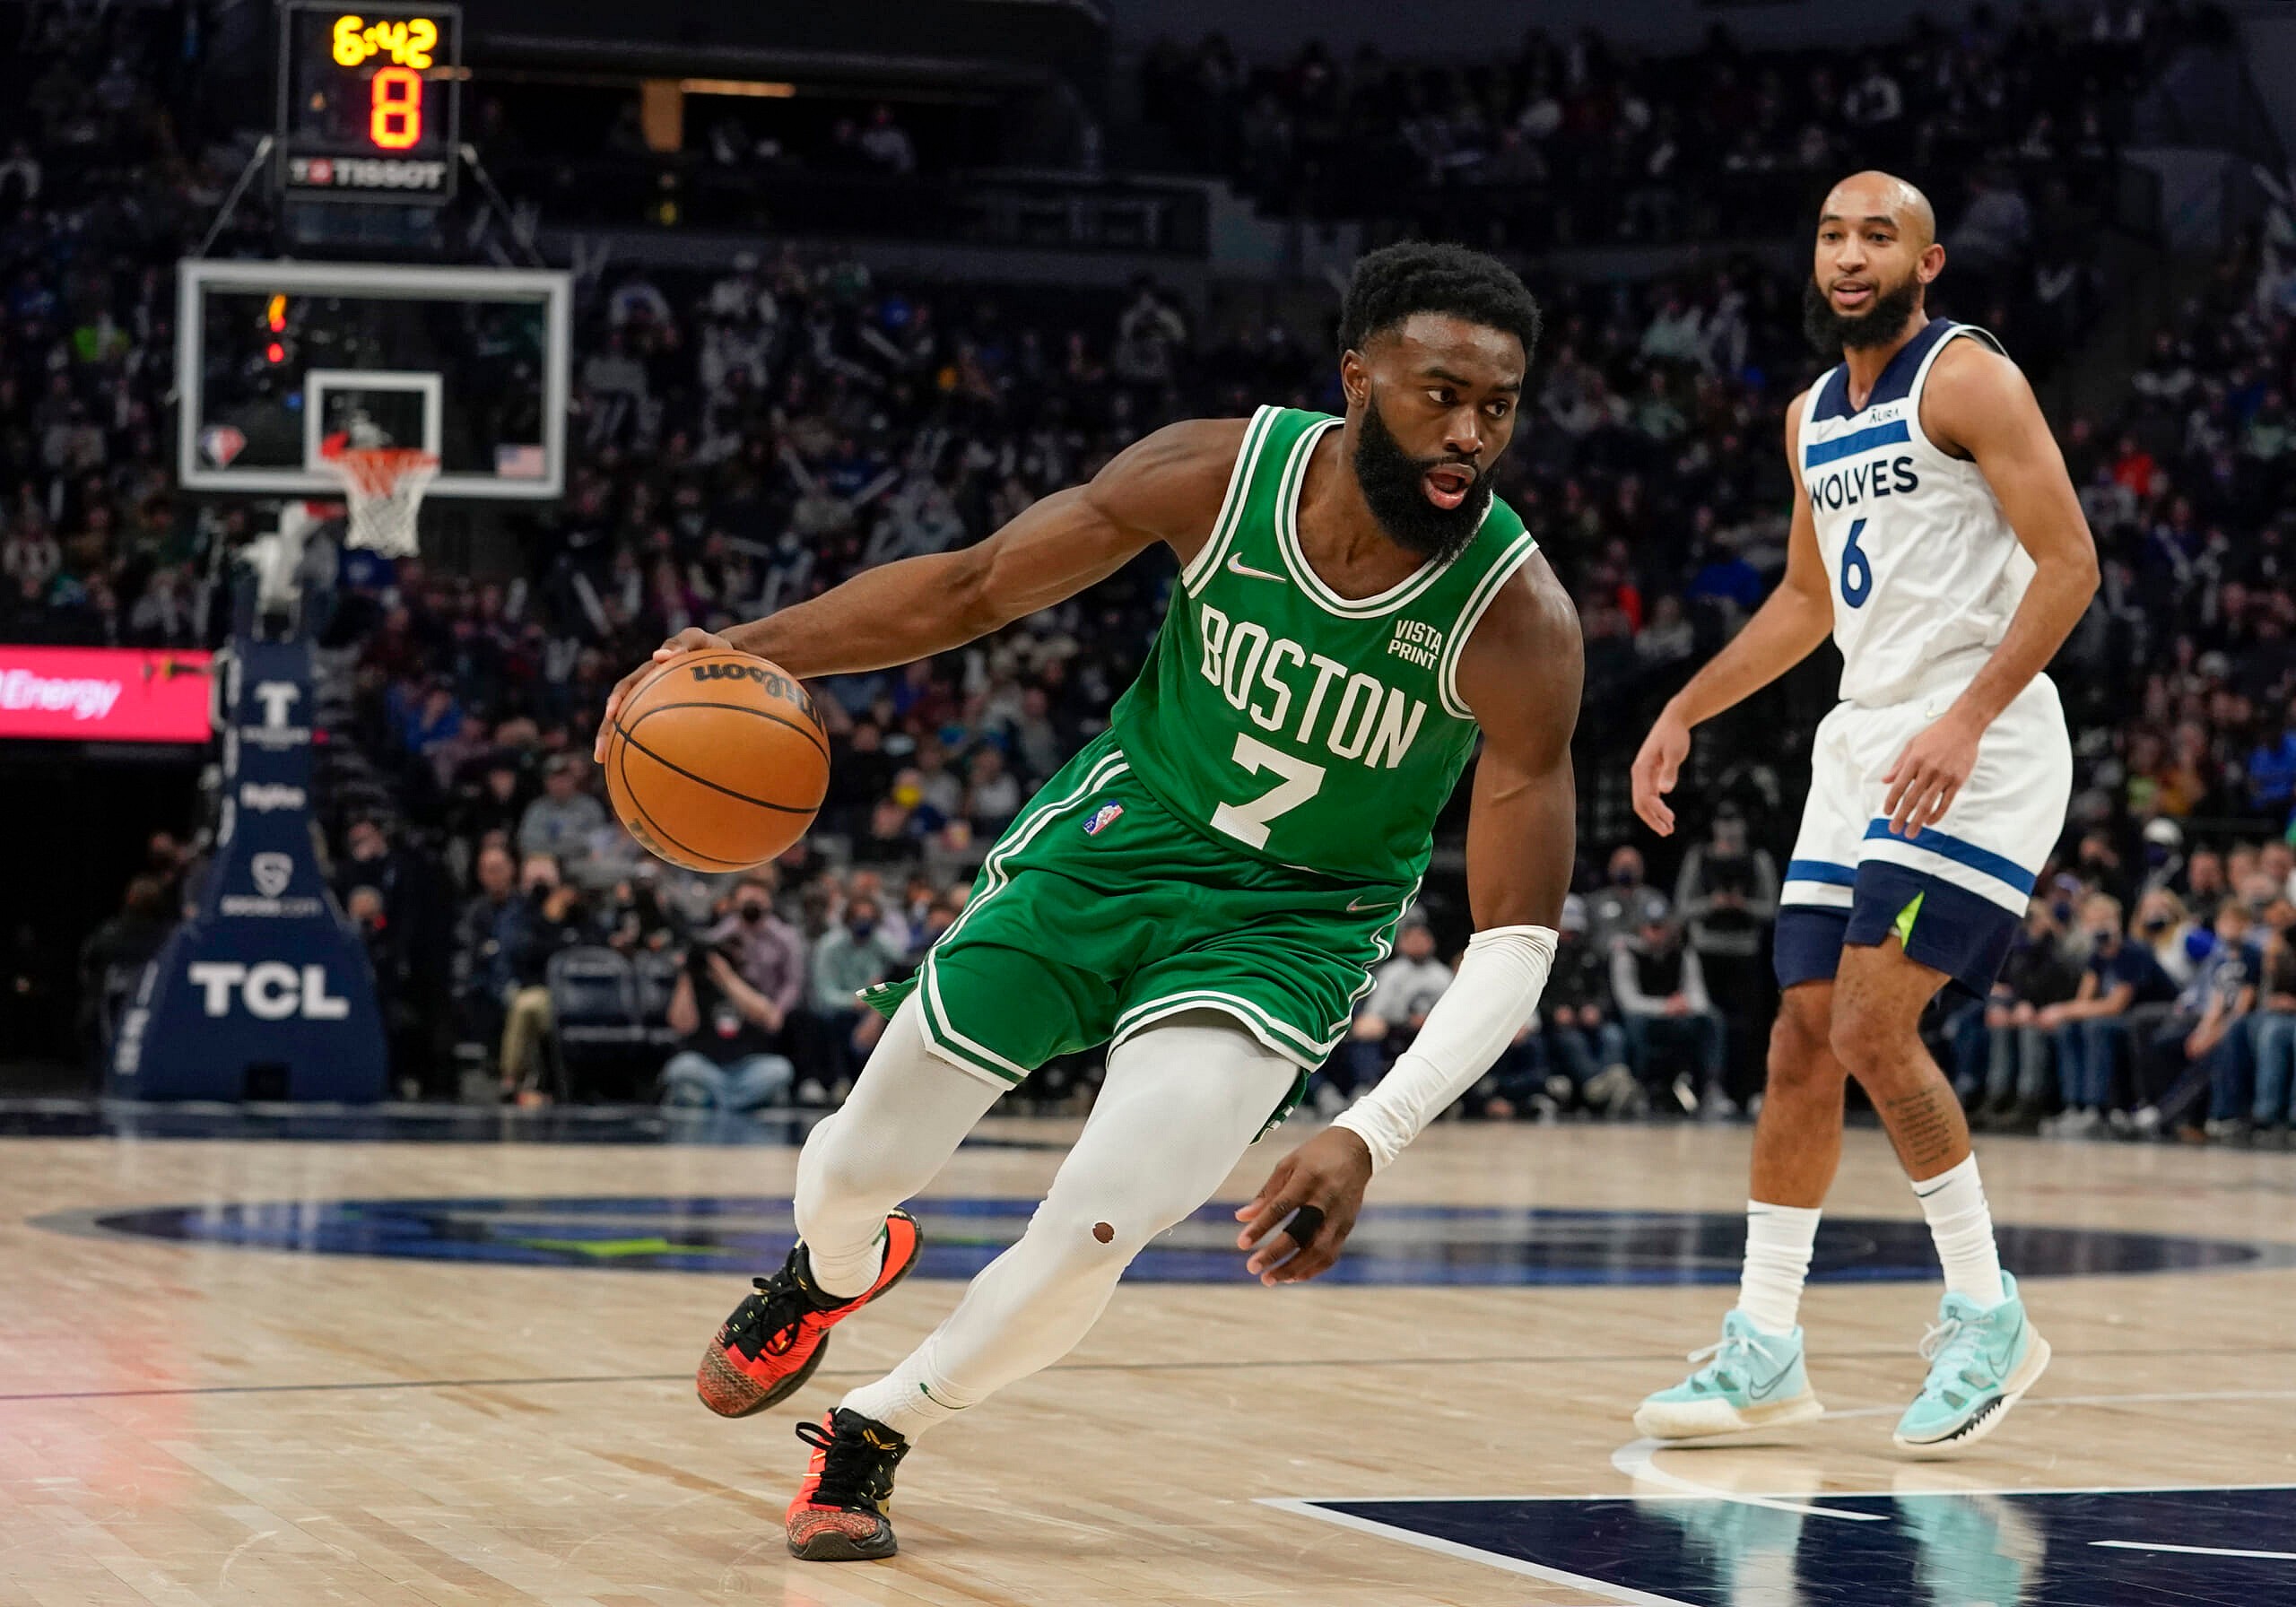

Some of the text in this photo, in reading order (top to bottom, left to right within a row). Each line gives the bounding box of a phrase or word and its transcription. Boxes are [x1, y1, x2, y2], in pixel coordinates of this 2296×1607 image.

[333, 14, 438, 69] 6:42
[370, 66, 422, 150] 8
[1807, 456, 1919, 514] WOLVES
[1840, 517, 1873, 609] 6
[1387, 639, 1437, 670] PRINT
[1395, 620, 1442, 656] VISTA
[3, 668, 122, 720] Energy
[1201, 604, 1428, 769] BOSTON
[1210, 732, 1326, 850] 7
[188, 961, 351, 1021] TCL
